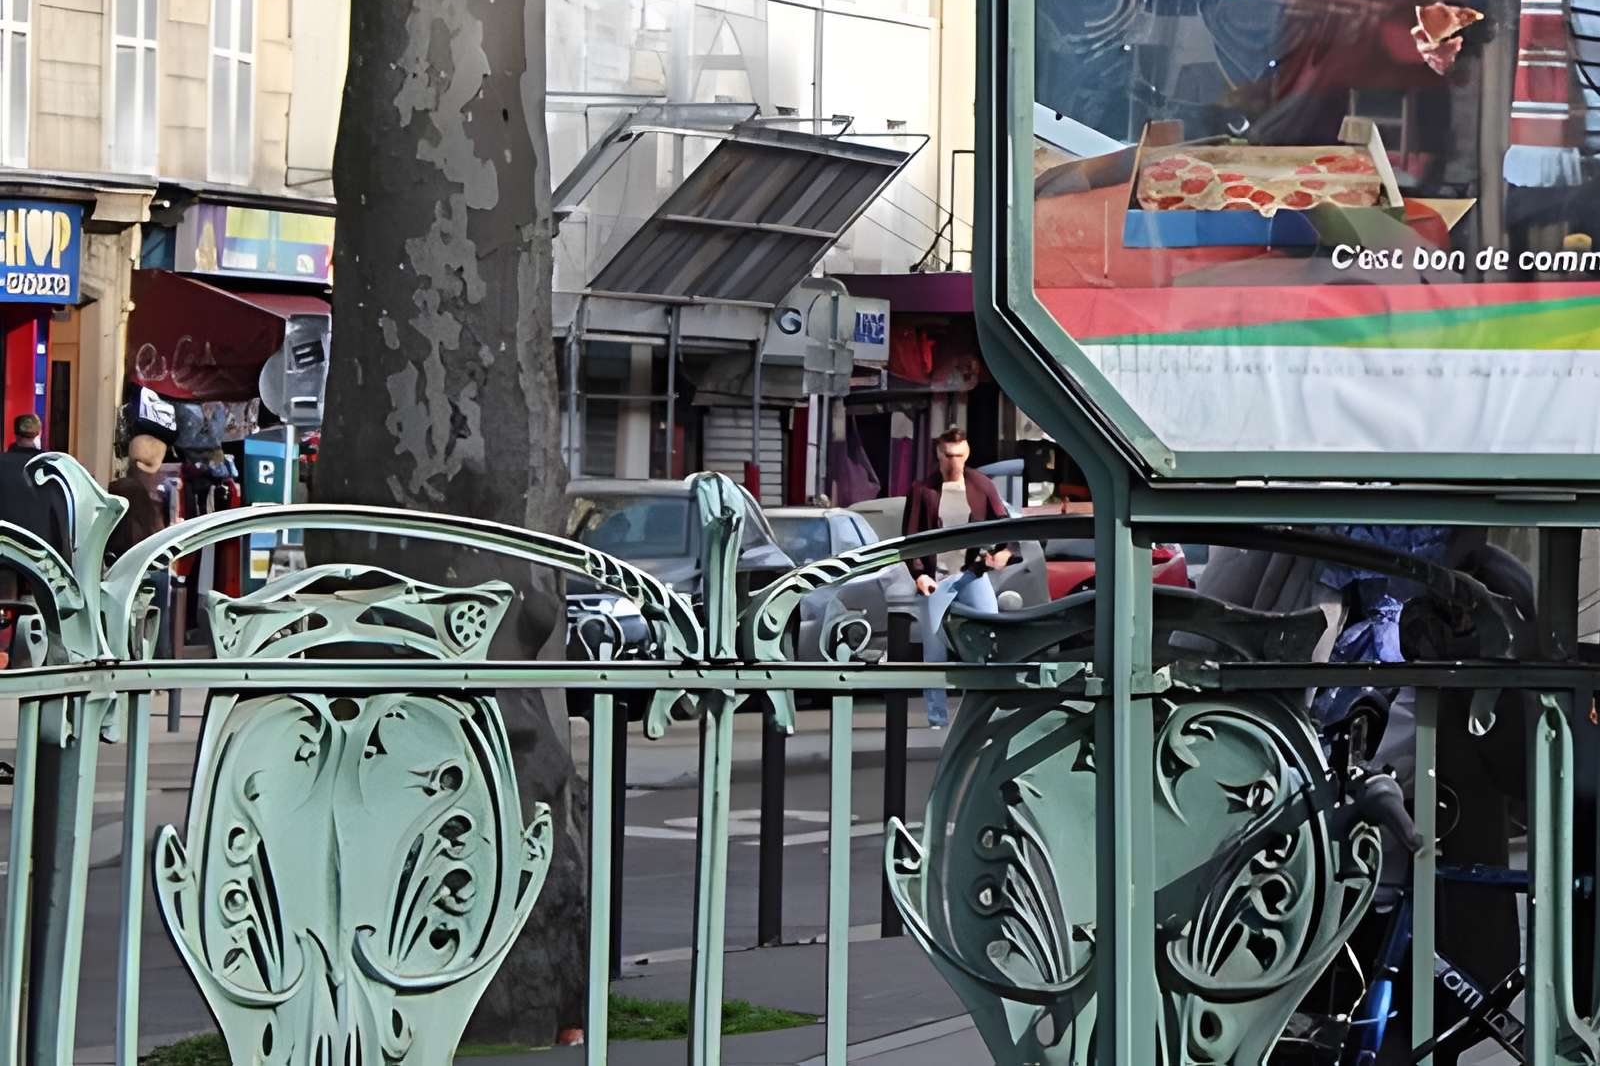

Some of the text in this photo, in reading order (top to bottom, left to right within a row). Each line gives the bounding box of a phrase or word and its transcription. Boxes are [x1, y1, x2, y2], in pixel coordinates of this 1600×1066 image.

[1331, 243, 1404, 270] C'est
[1412, 247, 1466, 272] bon
[1475, 245, 1509, 271] de
